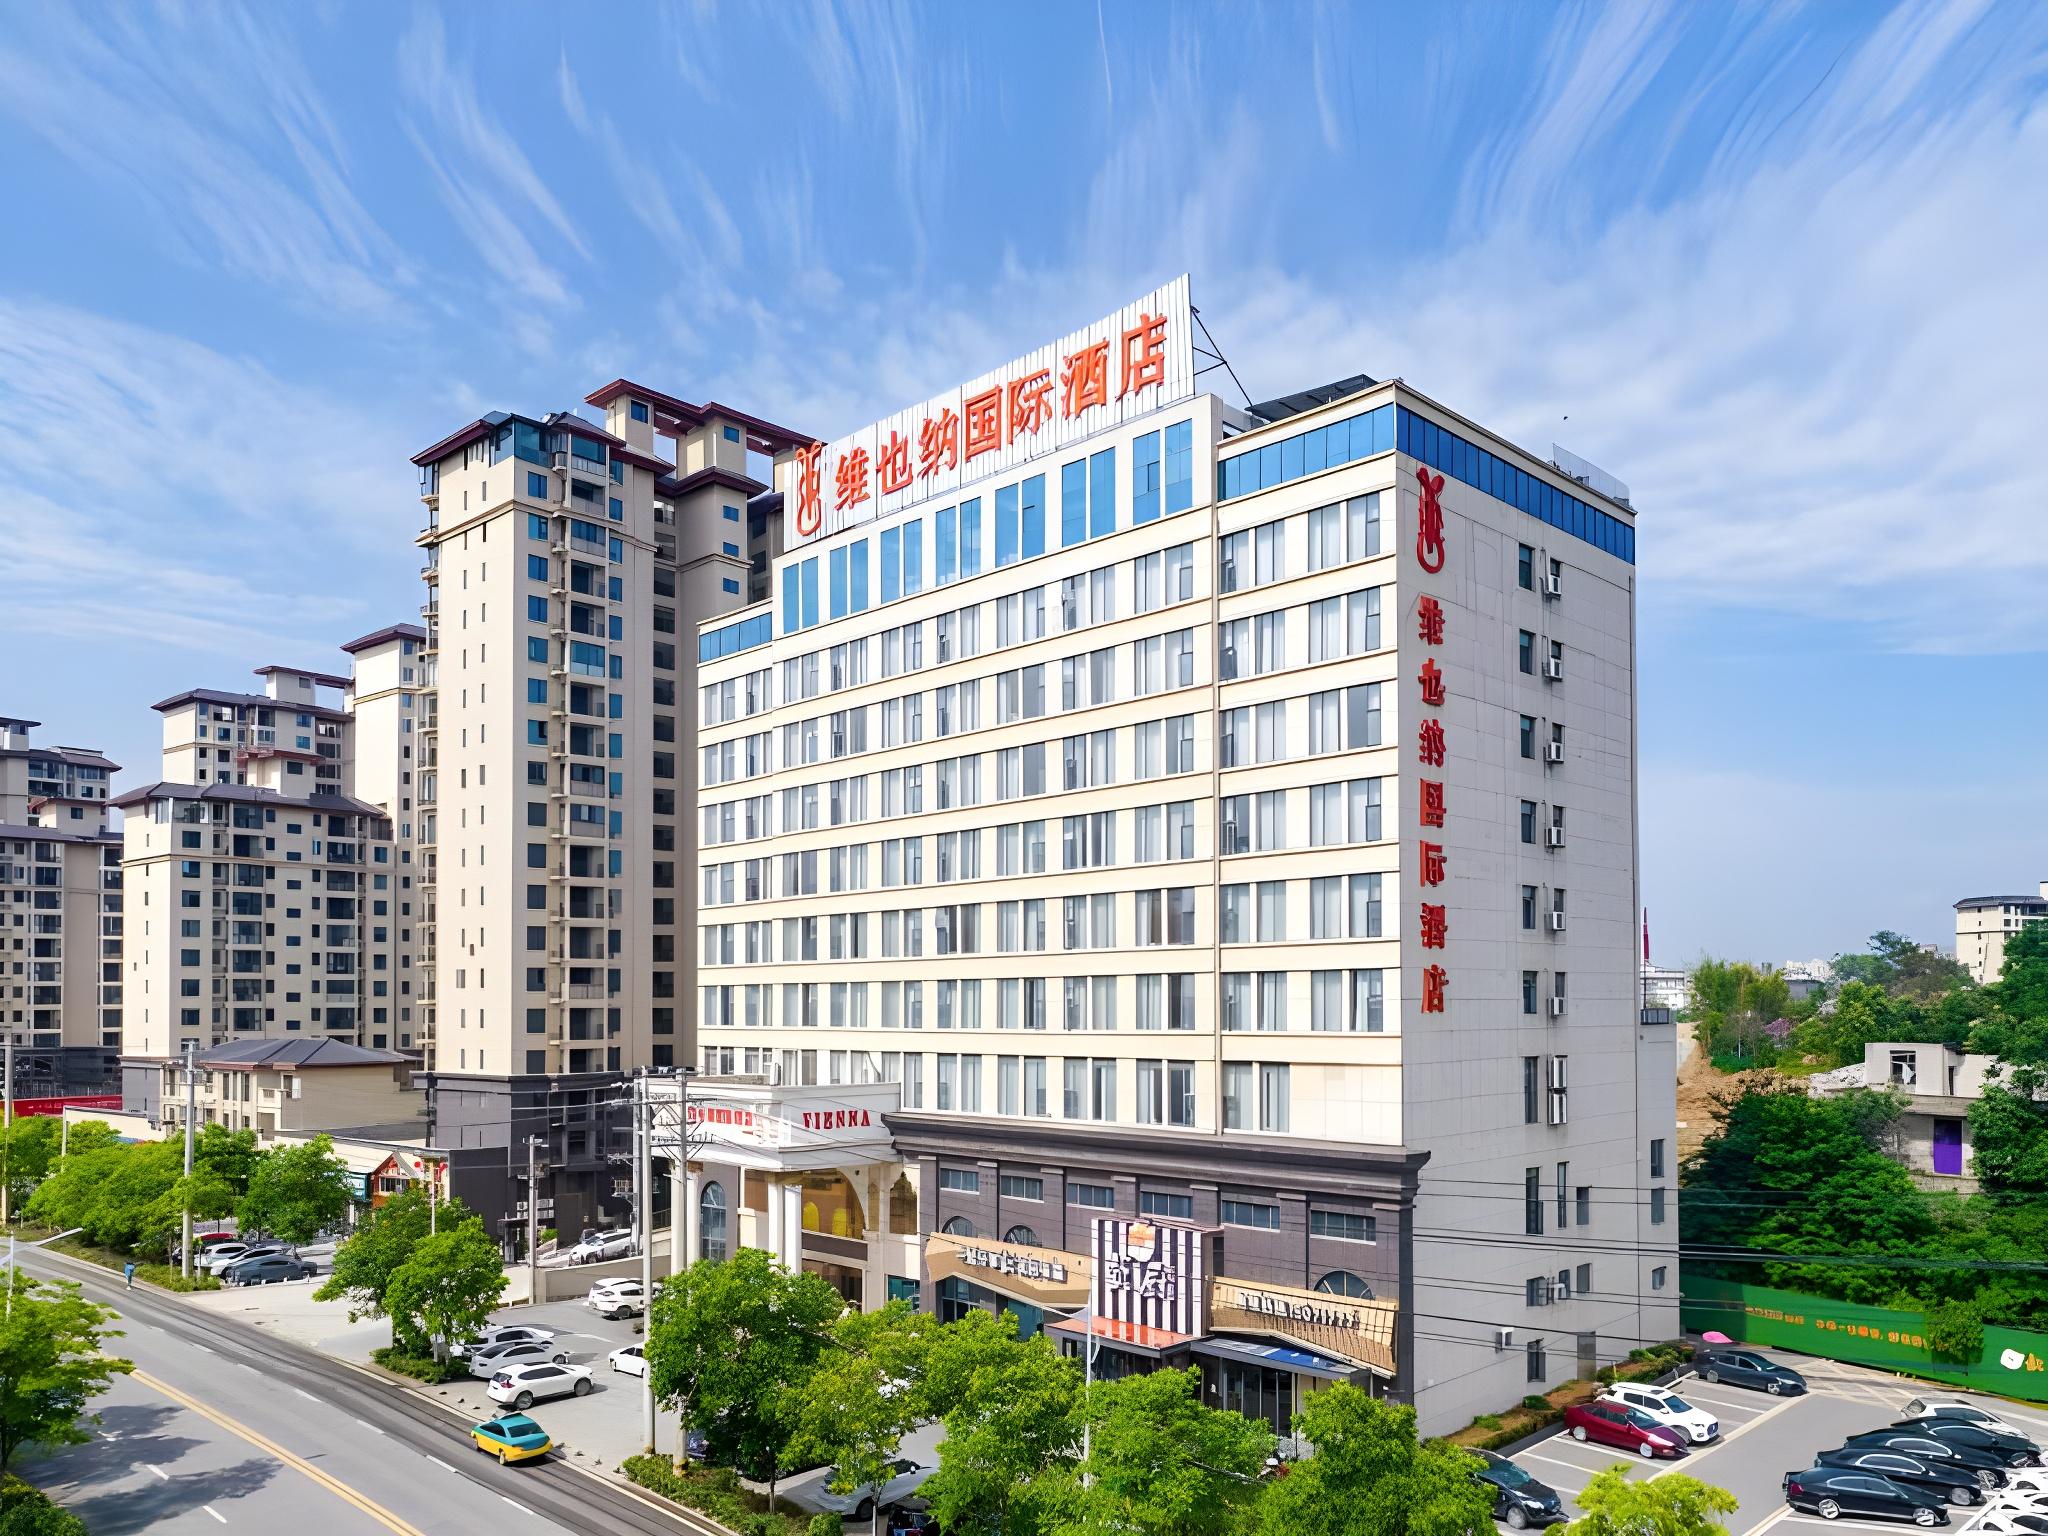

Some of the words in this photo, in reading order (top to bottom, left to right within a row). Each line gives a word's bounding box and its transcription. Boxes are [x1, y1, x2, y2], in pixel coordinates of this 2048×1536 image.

[834, 312, 1168, 511] 维也纳国际酒店
[802, 1109, 871, 1130] VIENNA
